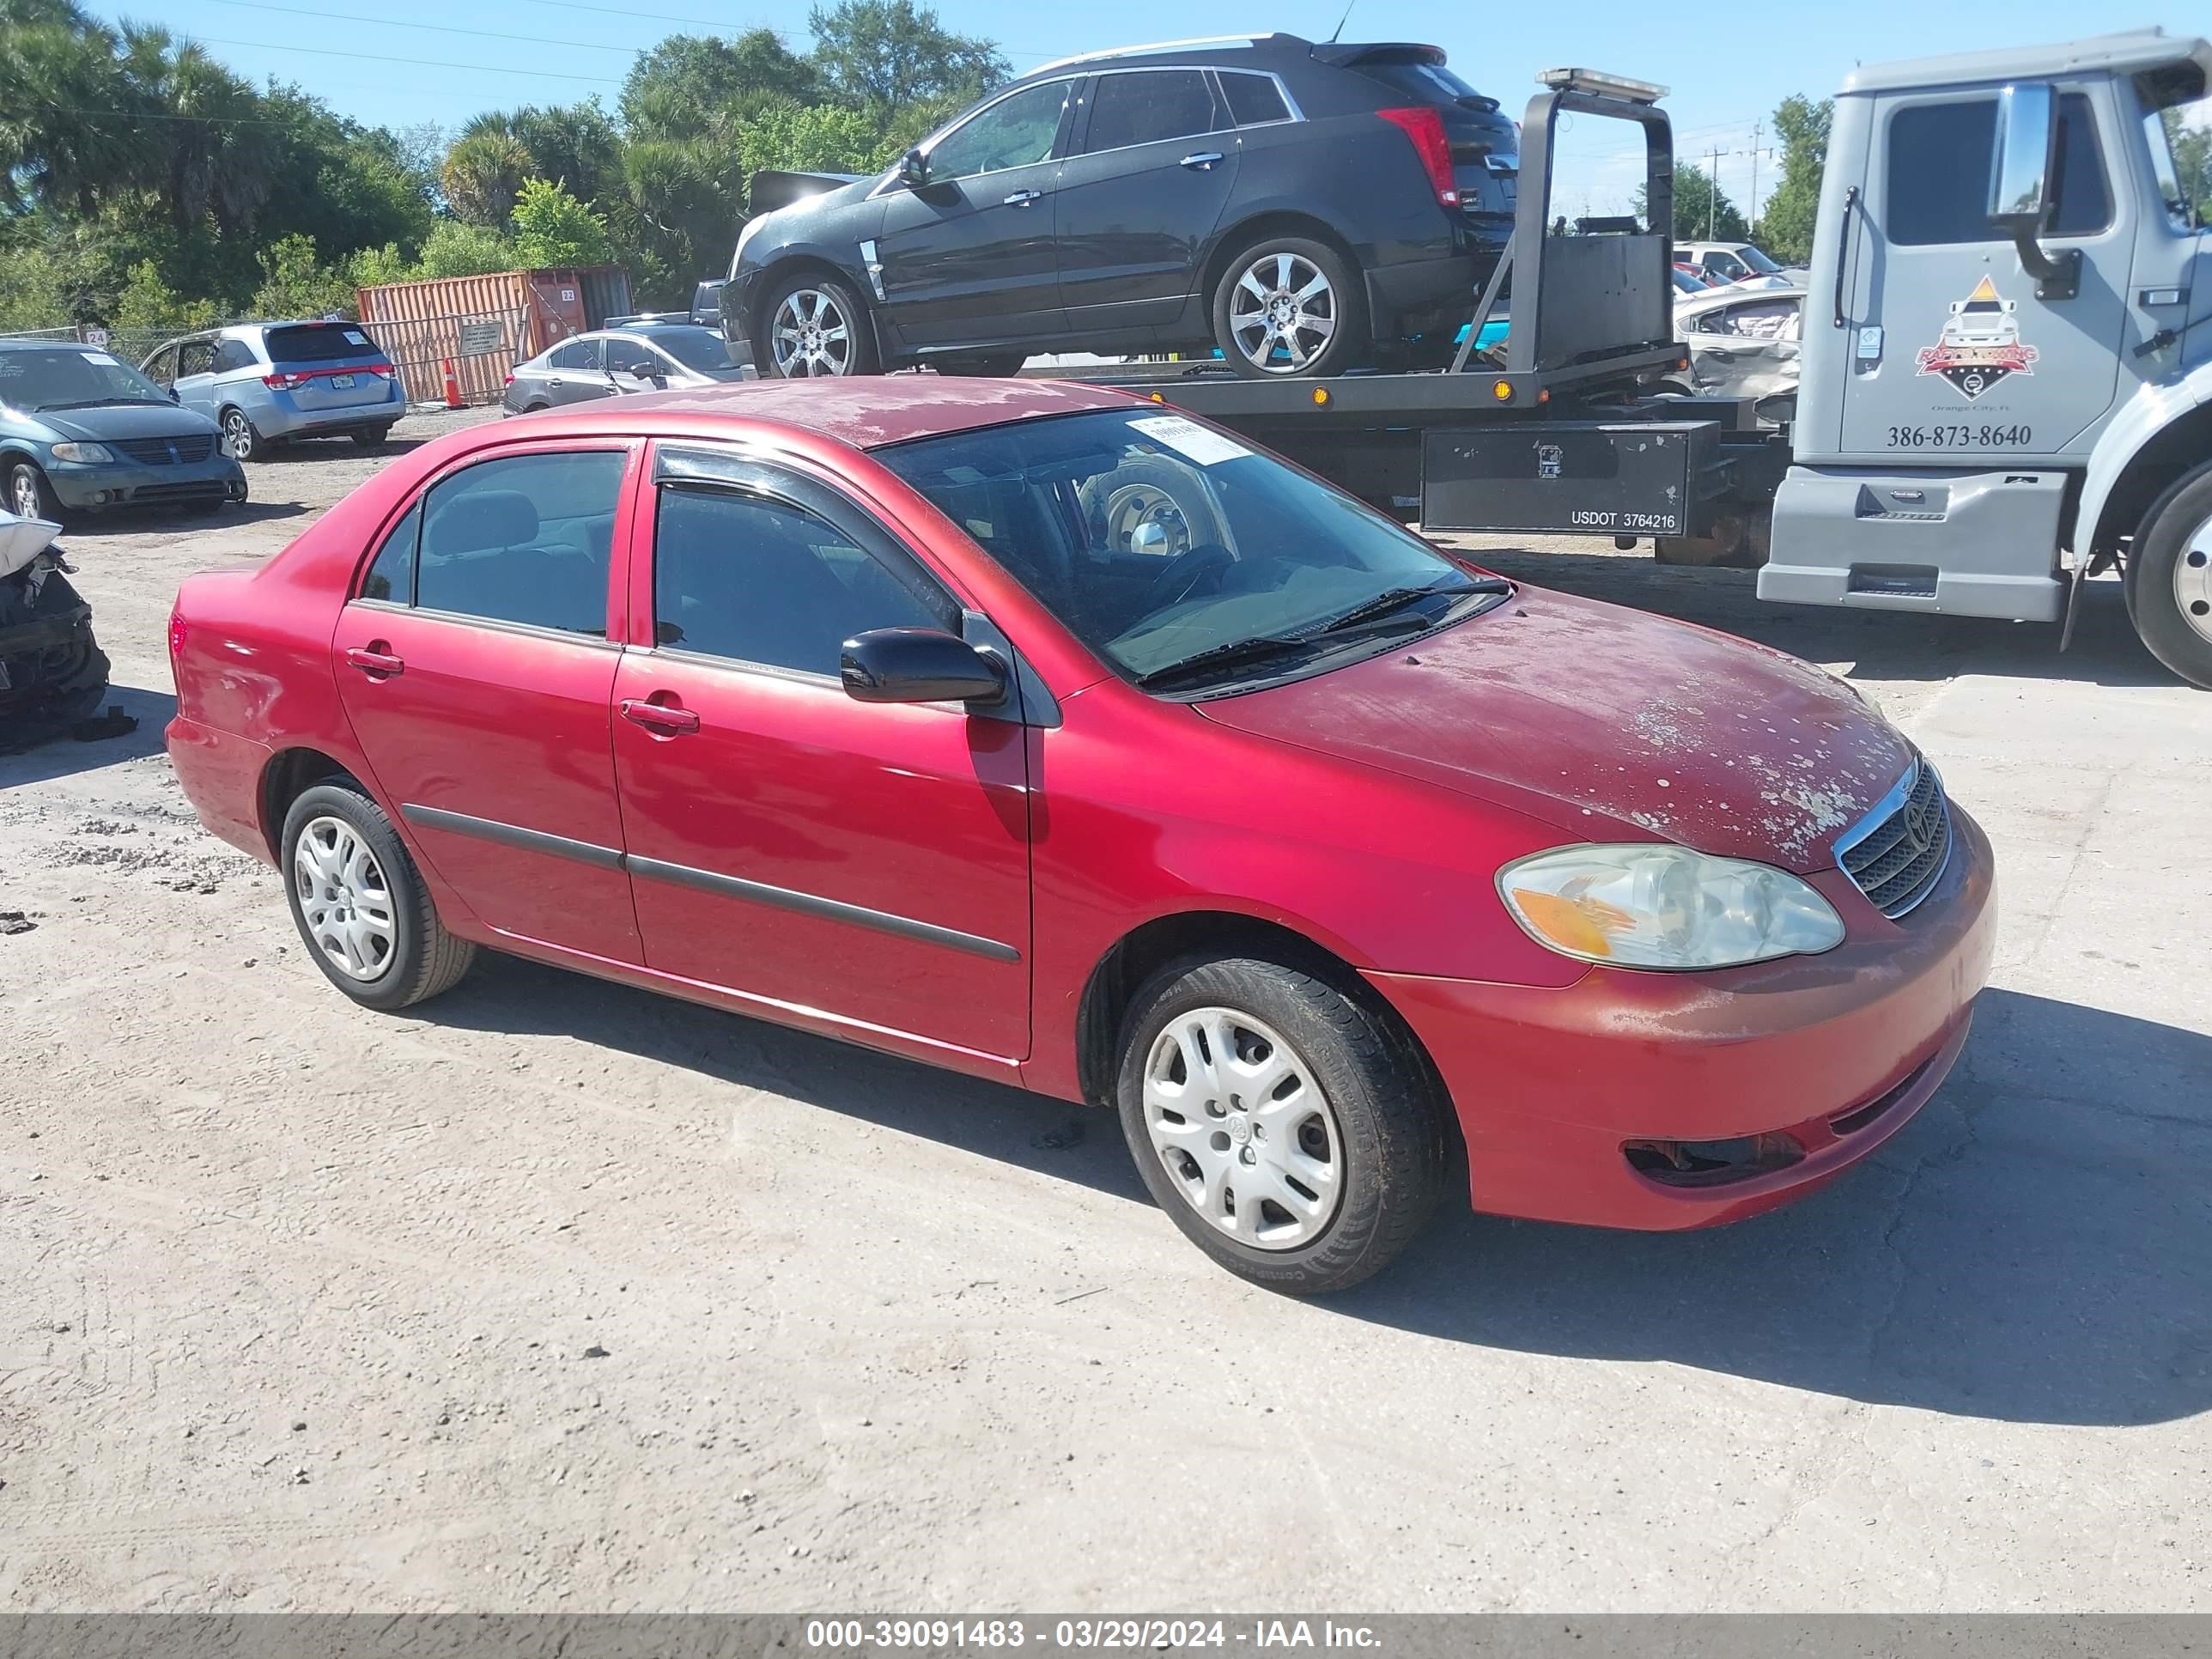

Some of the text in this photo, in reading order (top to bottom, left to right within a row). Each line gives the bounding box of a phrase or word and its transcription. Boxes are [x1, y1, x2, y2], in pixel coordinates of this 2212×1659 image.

[562, 291, 574, 300] 22
[89, 333, 104, 343] 24
[1975, 346, 2036, 361] TOWING
[1930, 404, 1971, 413] Orange
[1887, 425, 2032, 447] 386-873-8640
[1571, 510, 1675, 528] USDOT 3764216
